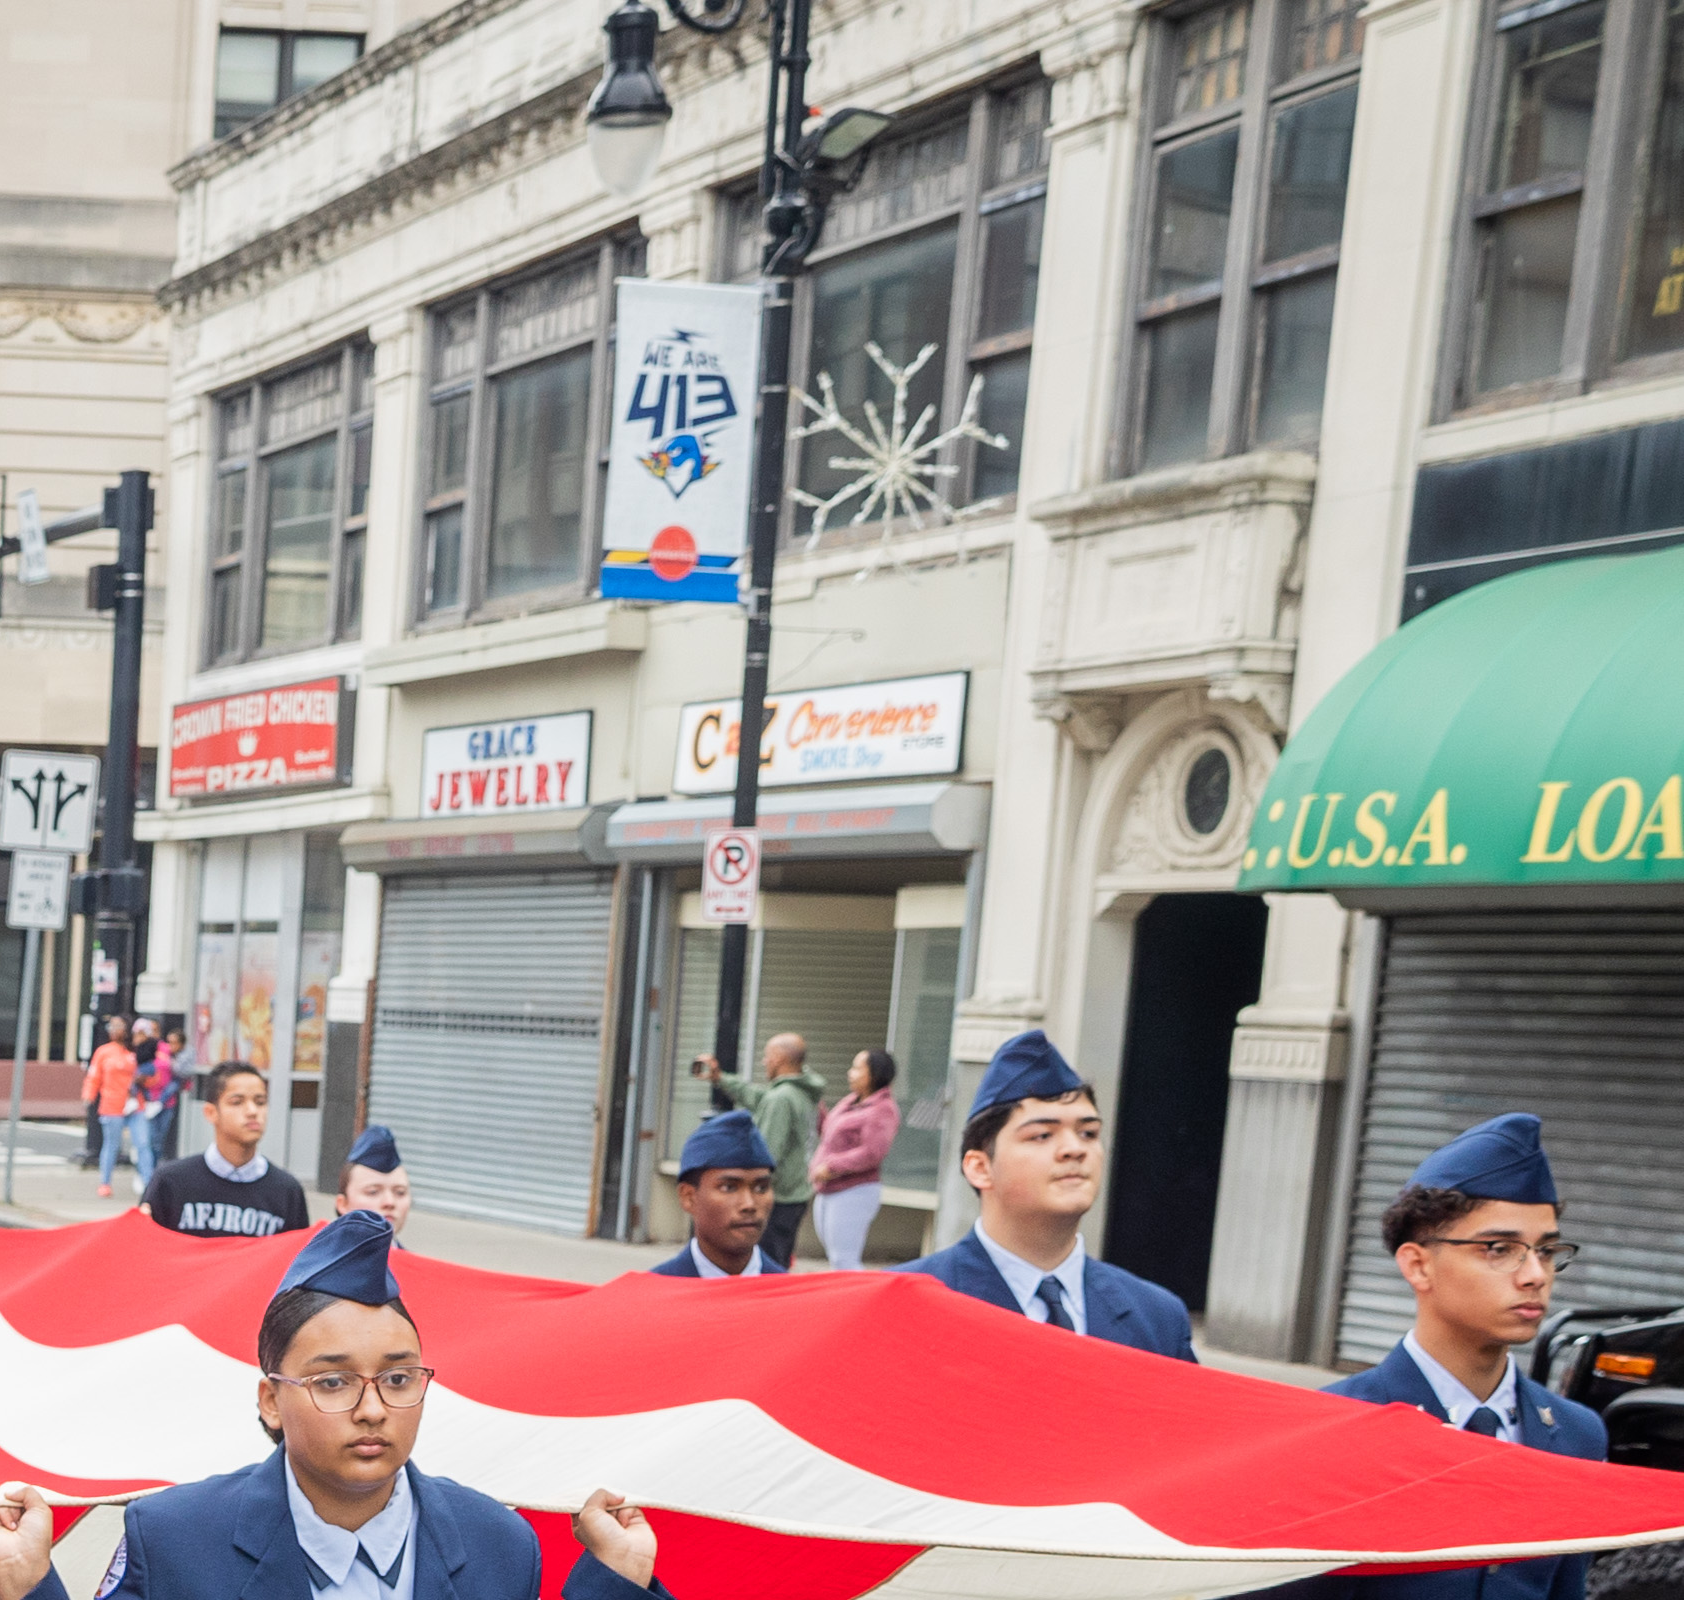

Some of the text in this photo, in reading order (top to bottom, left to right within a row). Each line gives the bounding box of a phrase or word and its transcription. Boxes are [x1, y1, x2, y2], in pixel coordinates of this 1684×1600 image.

[644, 344, 720, 368] WE ARE
[627, 374, 737, 440] 413
[173, 689, 339, 749] CROWN FRIED CHICKEN
[468, 724, 537, 760] GRACE
[694, 710, 722, 772] C
[787, 700, 938, 749] Convenience
[206, 757, 288, 793] PIZZA
[430, 761, 573, 811] JEWELRY
